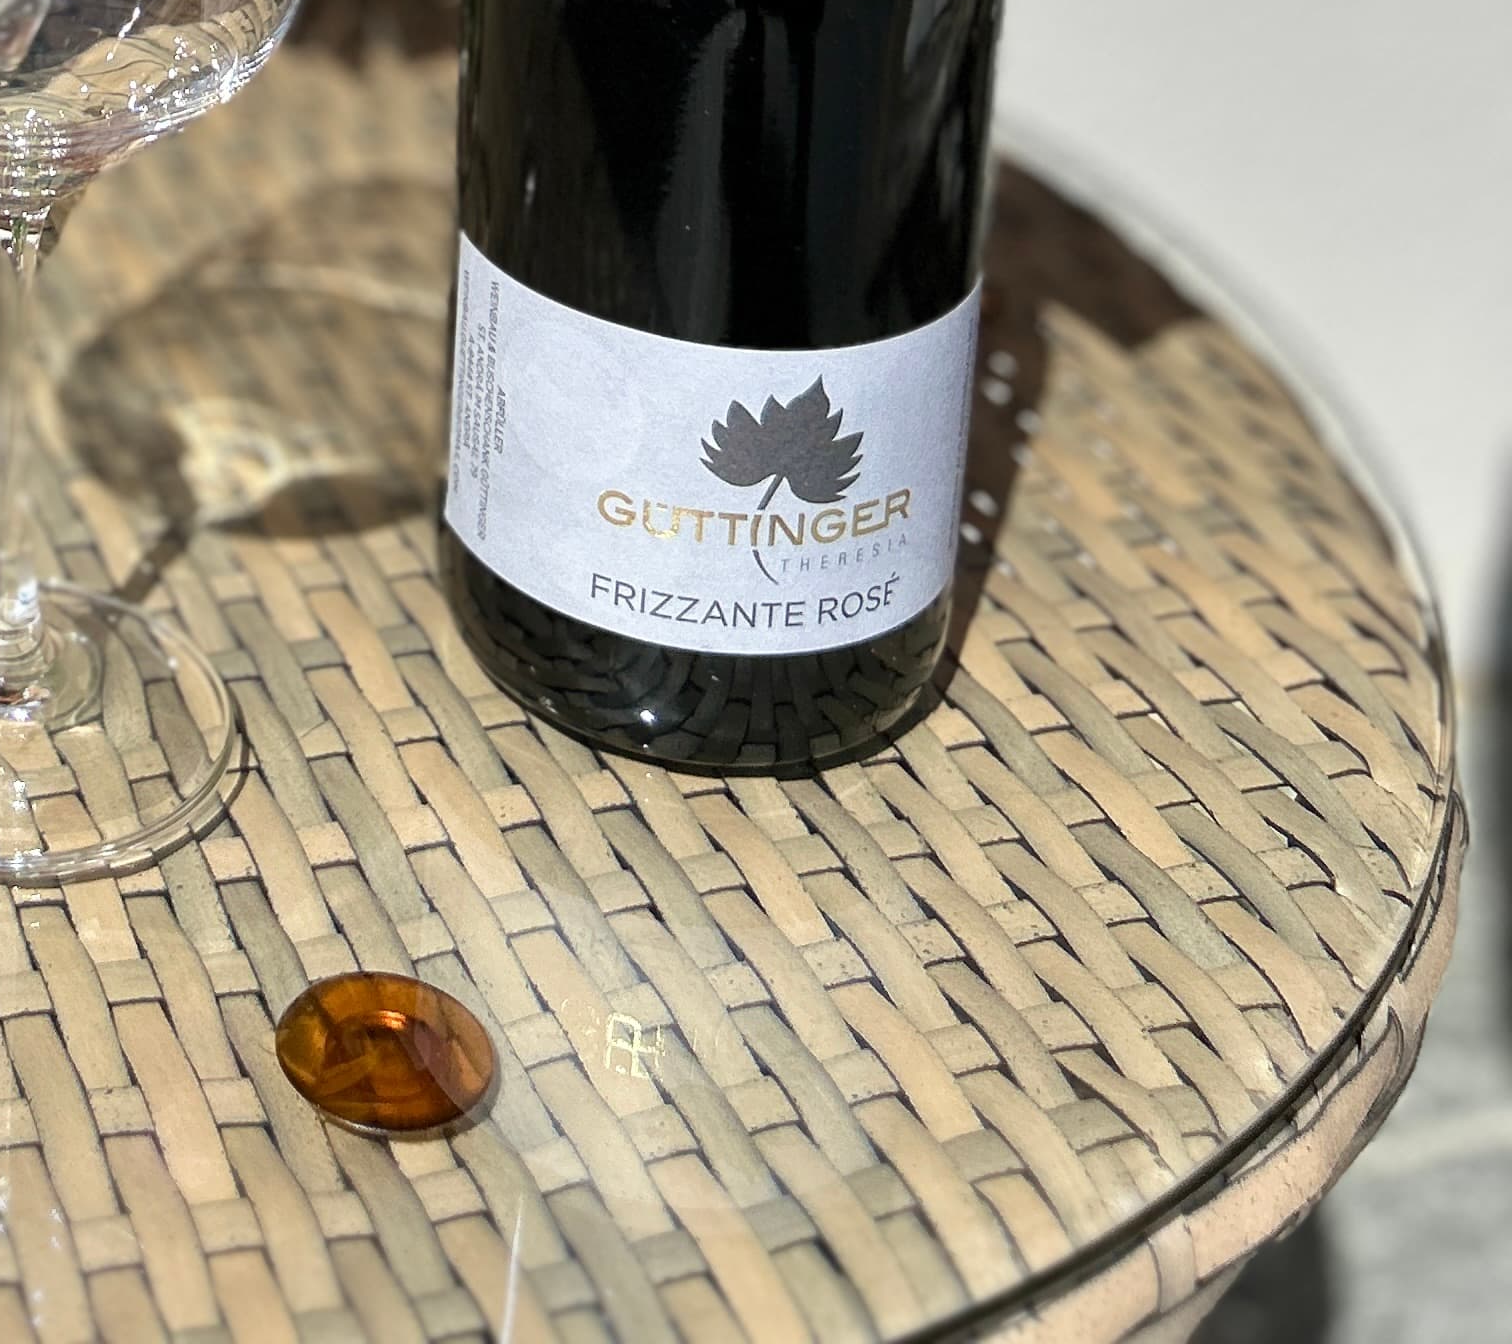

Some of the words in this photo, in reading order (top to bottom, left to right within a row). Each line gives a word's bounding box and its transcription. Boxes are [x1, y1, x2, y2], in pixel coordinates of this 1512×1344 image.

[488, 282, 499, 342] WEINBAU
[494, 385, 506, 454] ABFÜLLER
[597, 489, 911, 547] GÜTTINGER
[781, 533, 907, 573] THERESIA
[591, 573, 806, 628] FRIZZANTE
[818, 571, 900, 624] ROSÉ
